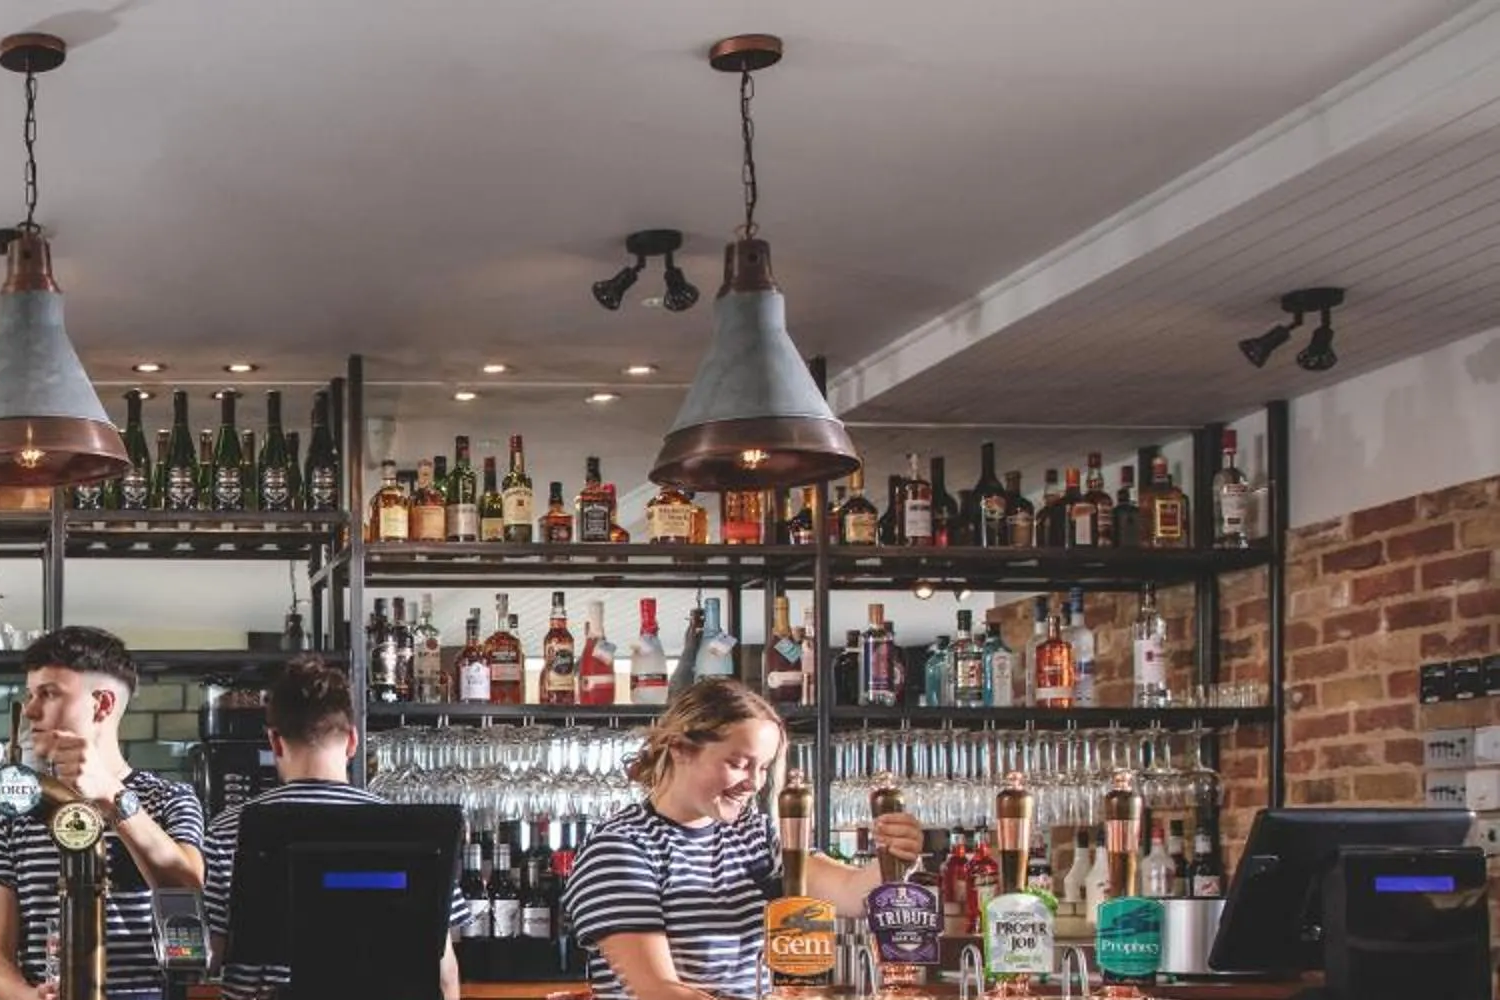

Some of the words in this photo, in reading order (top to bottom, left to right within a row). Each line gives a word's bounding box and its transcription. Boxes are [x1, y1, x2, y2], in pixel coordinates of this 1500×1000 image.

[875, 910, 938, 928] TRIBUTE
[995, 921, 1048, 936] PROPER
[771, 934, 833, 956] Gem
[1011, 936, 1037, 952] JOB
[1101, 938, 1159, 955] Prophecy
